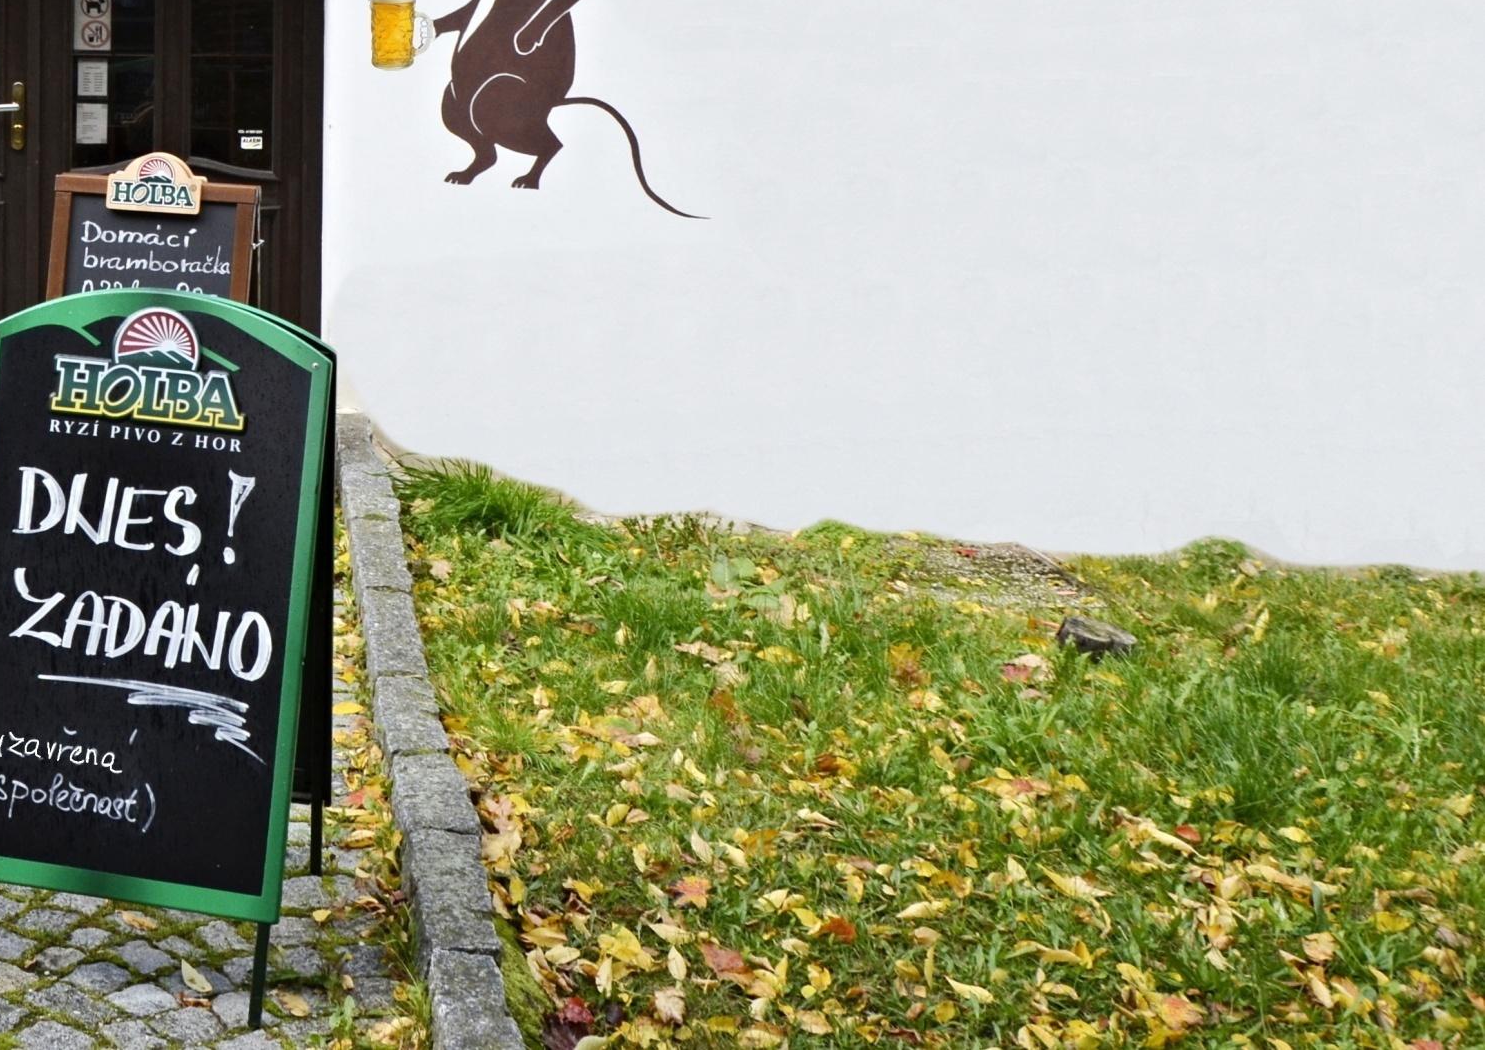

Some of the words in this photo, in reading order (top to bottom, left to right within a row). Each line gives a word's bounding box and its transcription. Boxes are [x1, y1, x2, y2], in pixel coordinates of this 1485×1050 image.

[112, 180, 195, 208] HOLBA
[81, 221, 198, 248] Domácí
[51, 355, 245, 431] HOLBA
[49, 418, 100, 437] RYZÍ
[109, 425, 162, 444] PIVO
[172, 432, 183, 445] Z
[195, 434, 242, 453] HOR
